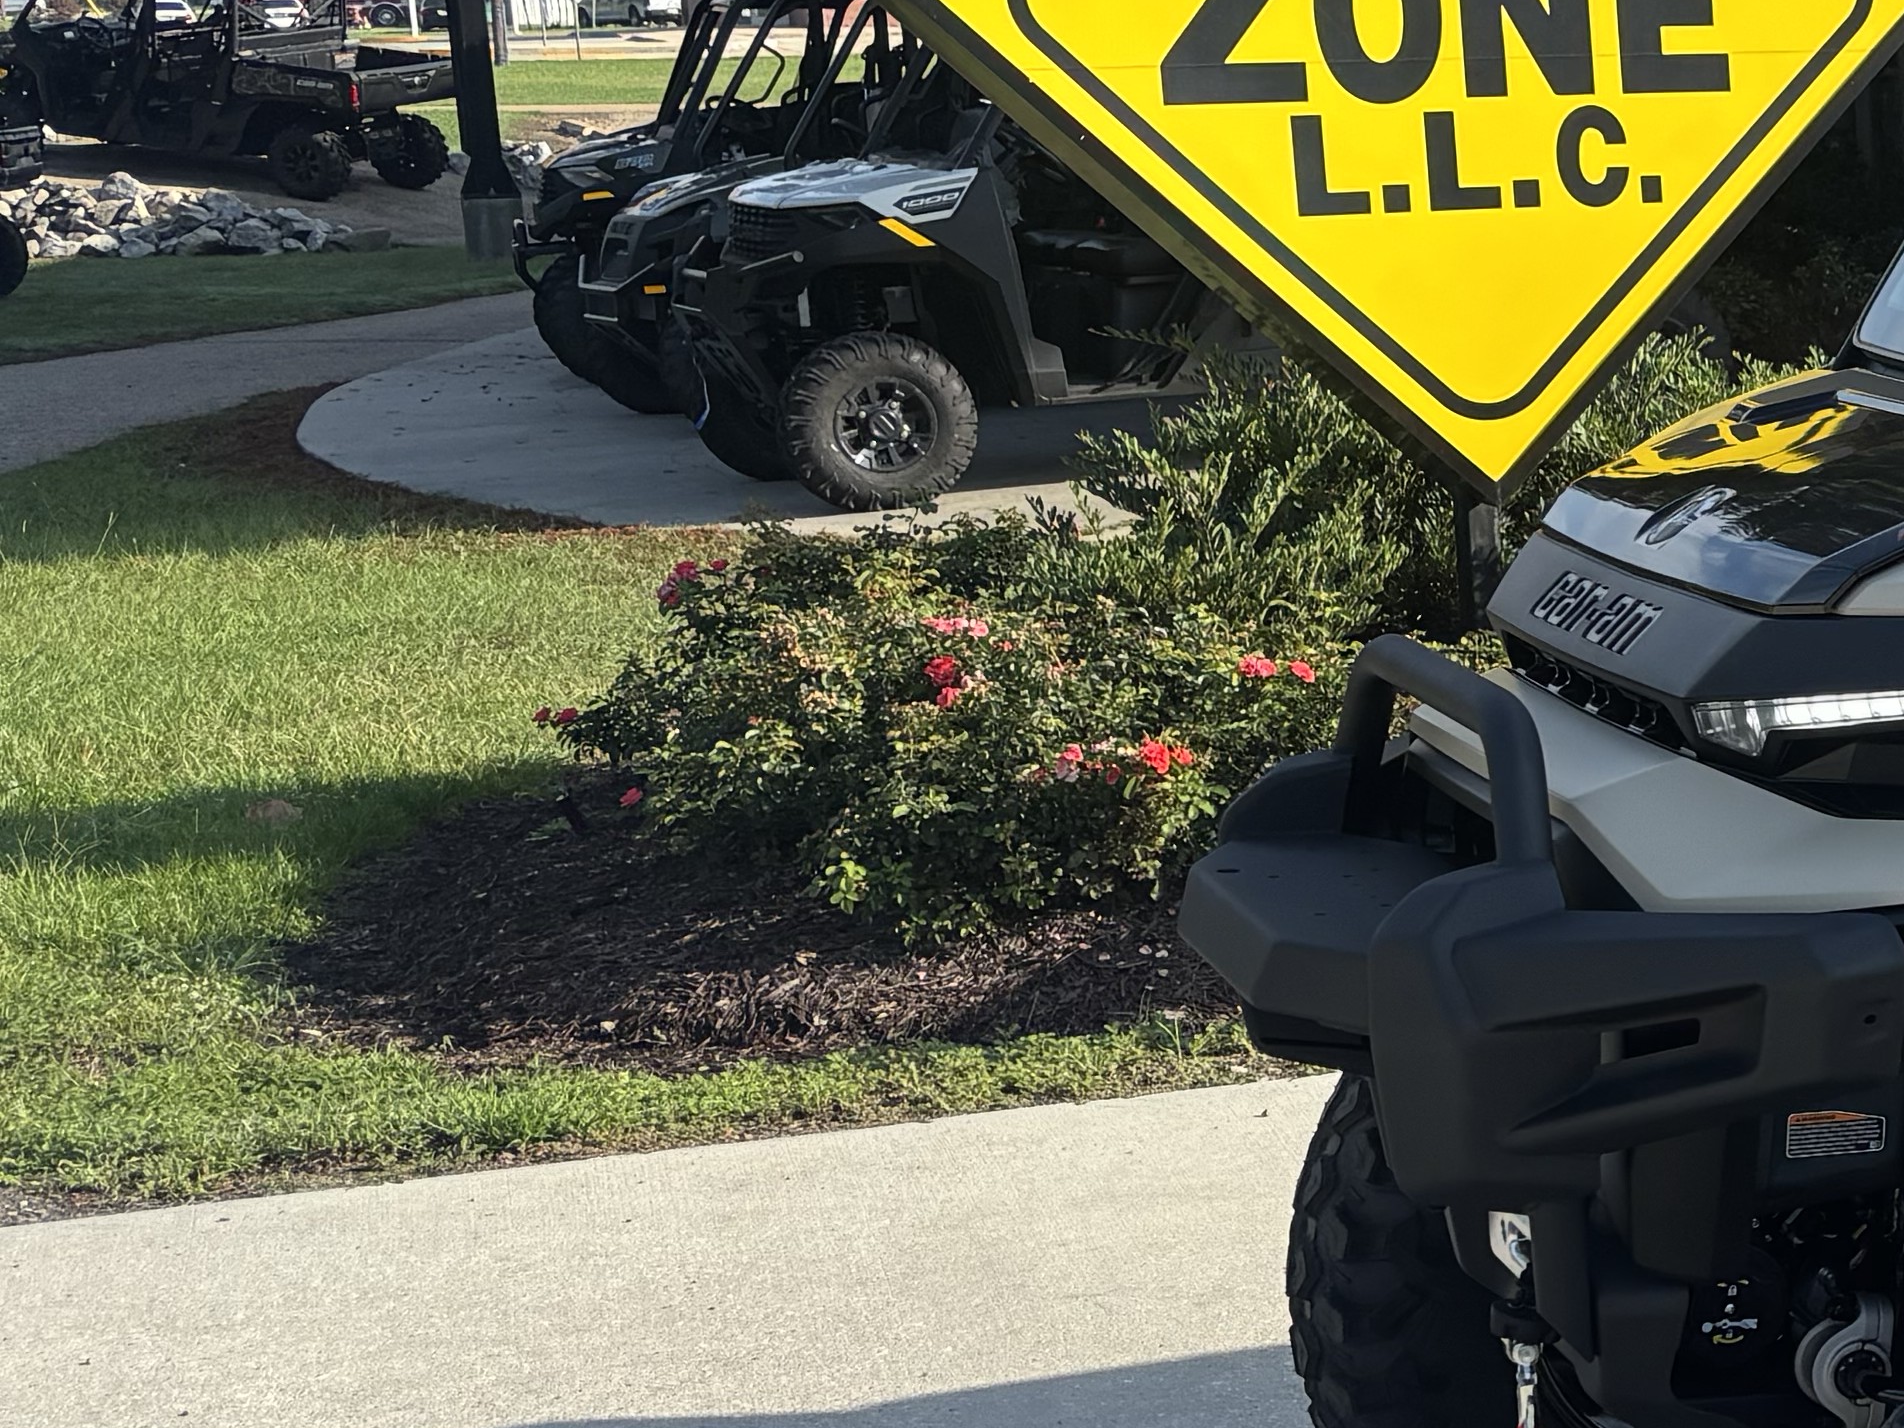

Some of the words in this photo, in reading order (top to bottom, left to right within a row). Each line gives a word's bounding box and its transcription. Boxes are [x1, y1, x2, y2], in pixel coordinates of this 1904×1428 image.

[902, 191, 960, 209] 1000
[1290, 105, 1664, 217] L.L.C.
[1530, 570, 1664, 655] can-am
